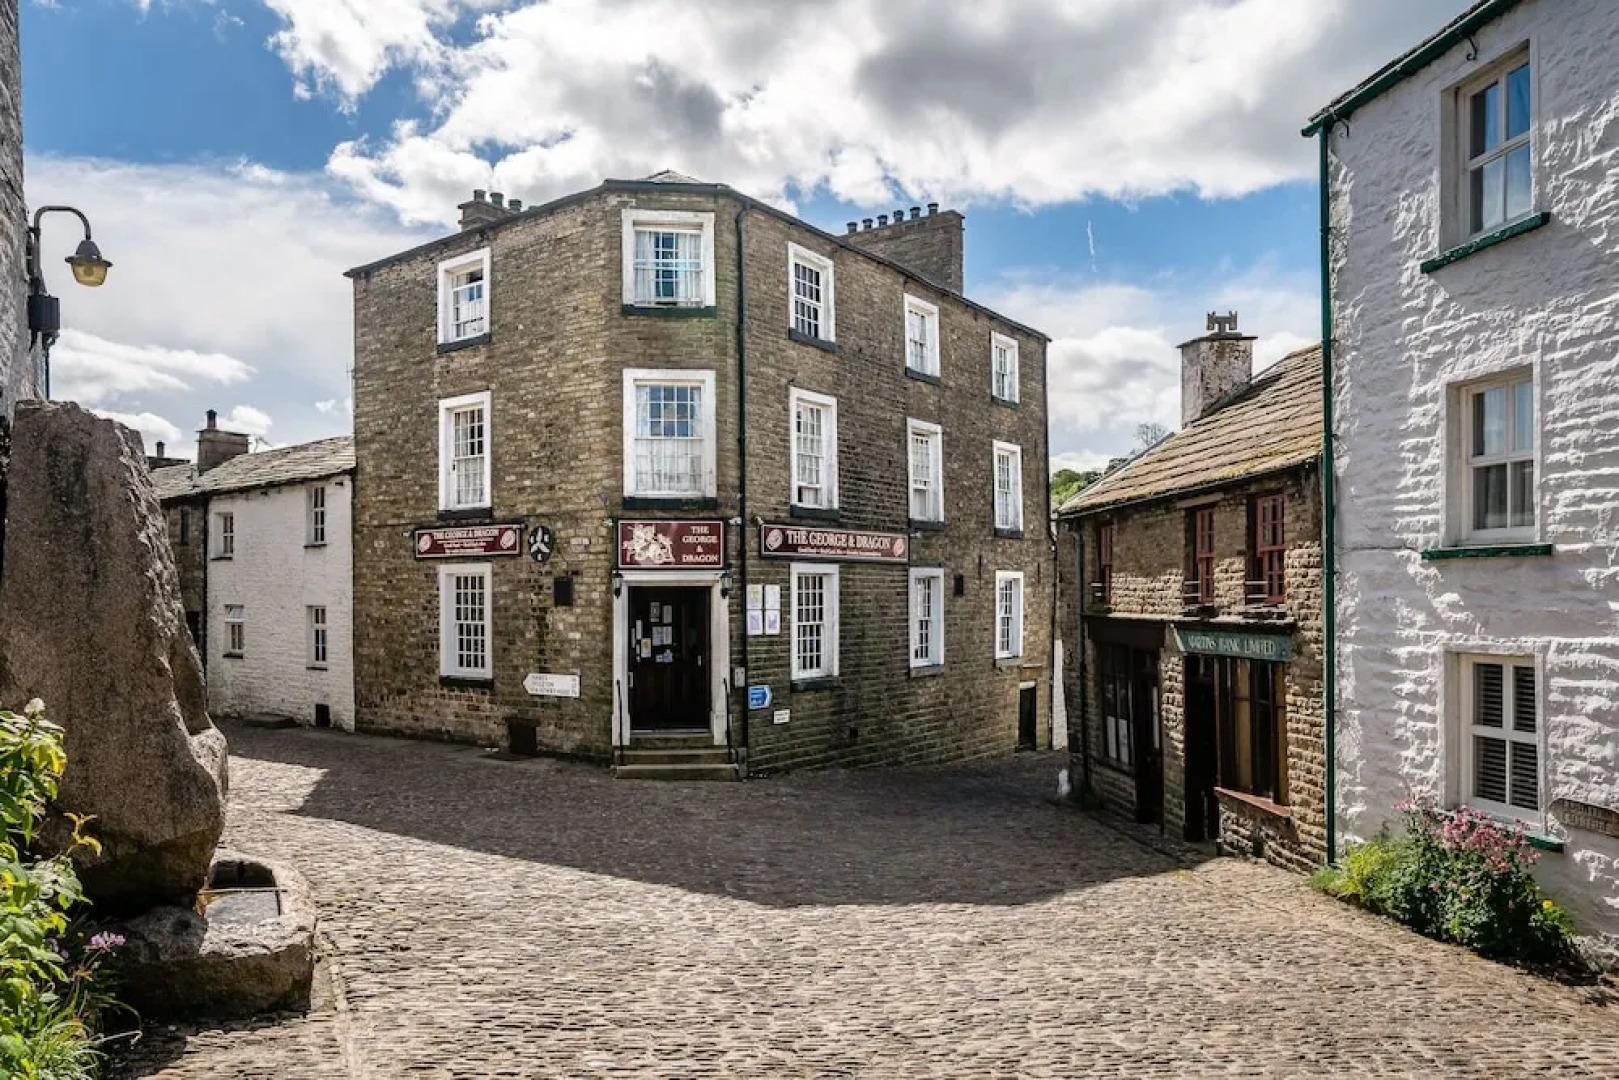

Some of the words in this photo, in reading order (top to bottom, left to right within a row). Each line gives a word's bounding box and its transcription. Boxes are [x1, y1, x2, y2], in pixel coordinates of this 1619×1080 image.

[690, 525, 710, 534] THE
[682, 535, 718, 544] GEORGE
[786, 530, 808, 545] THE
[809, 531, 847, 547] GEORGE
[848, 534, 856, 547] &
[856, 535, 891, 550] DRAGON
[695, 545, 704, 553] &
[682, 554, 719, 563] DRAGON
[1244, 639, 1275, 655] LIMITED
